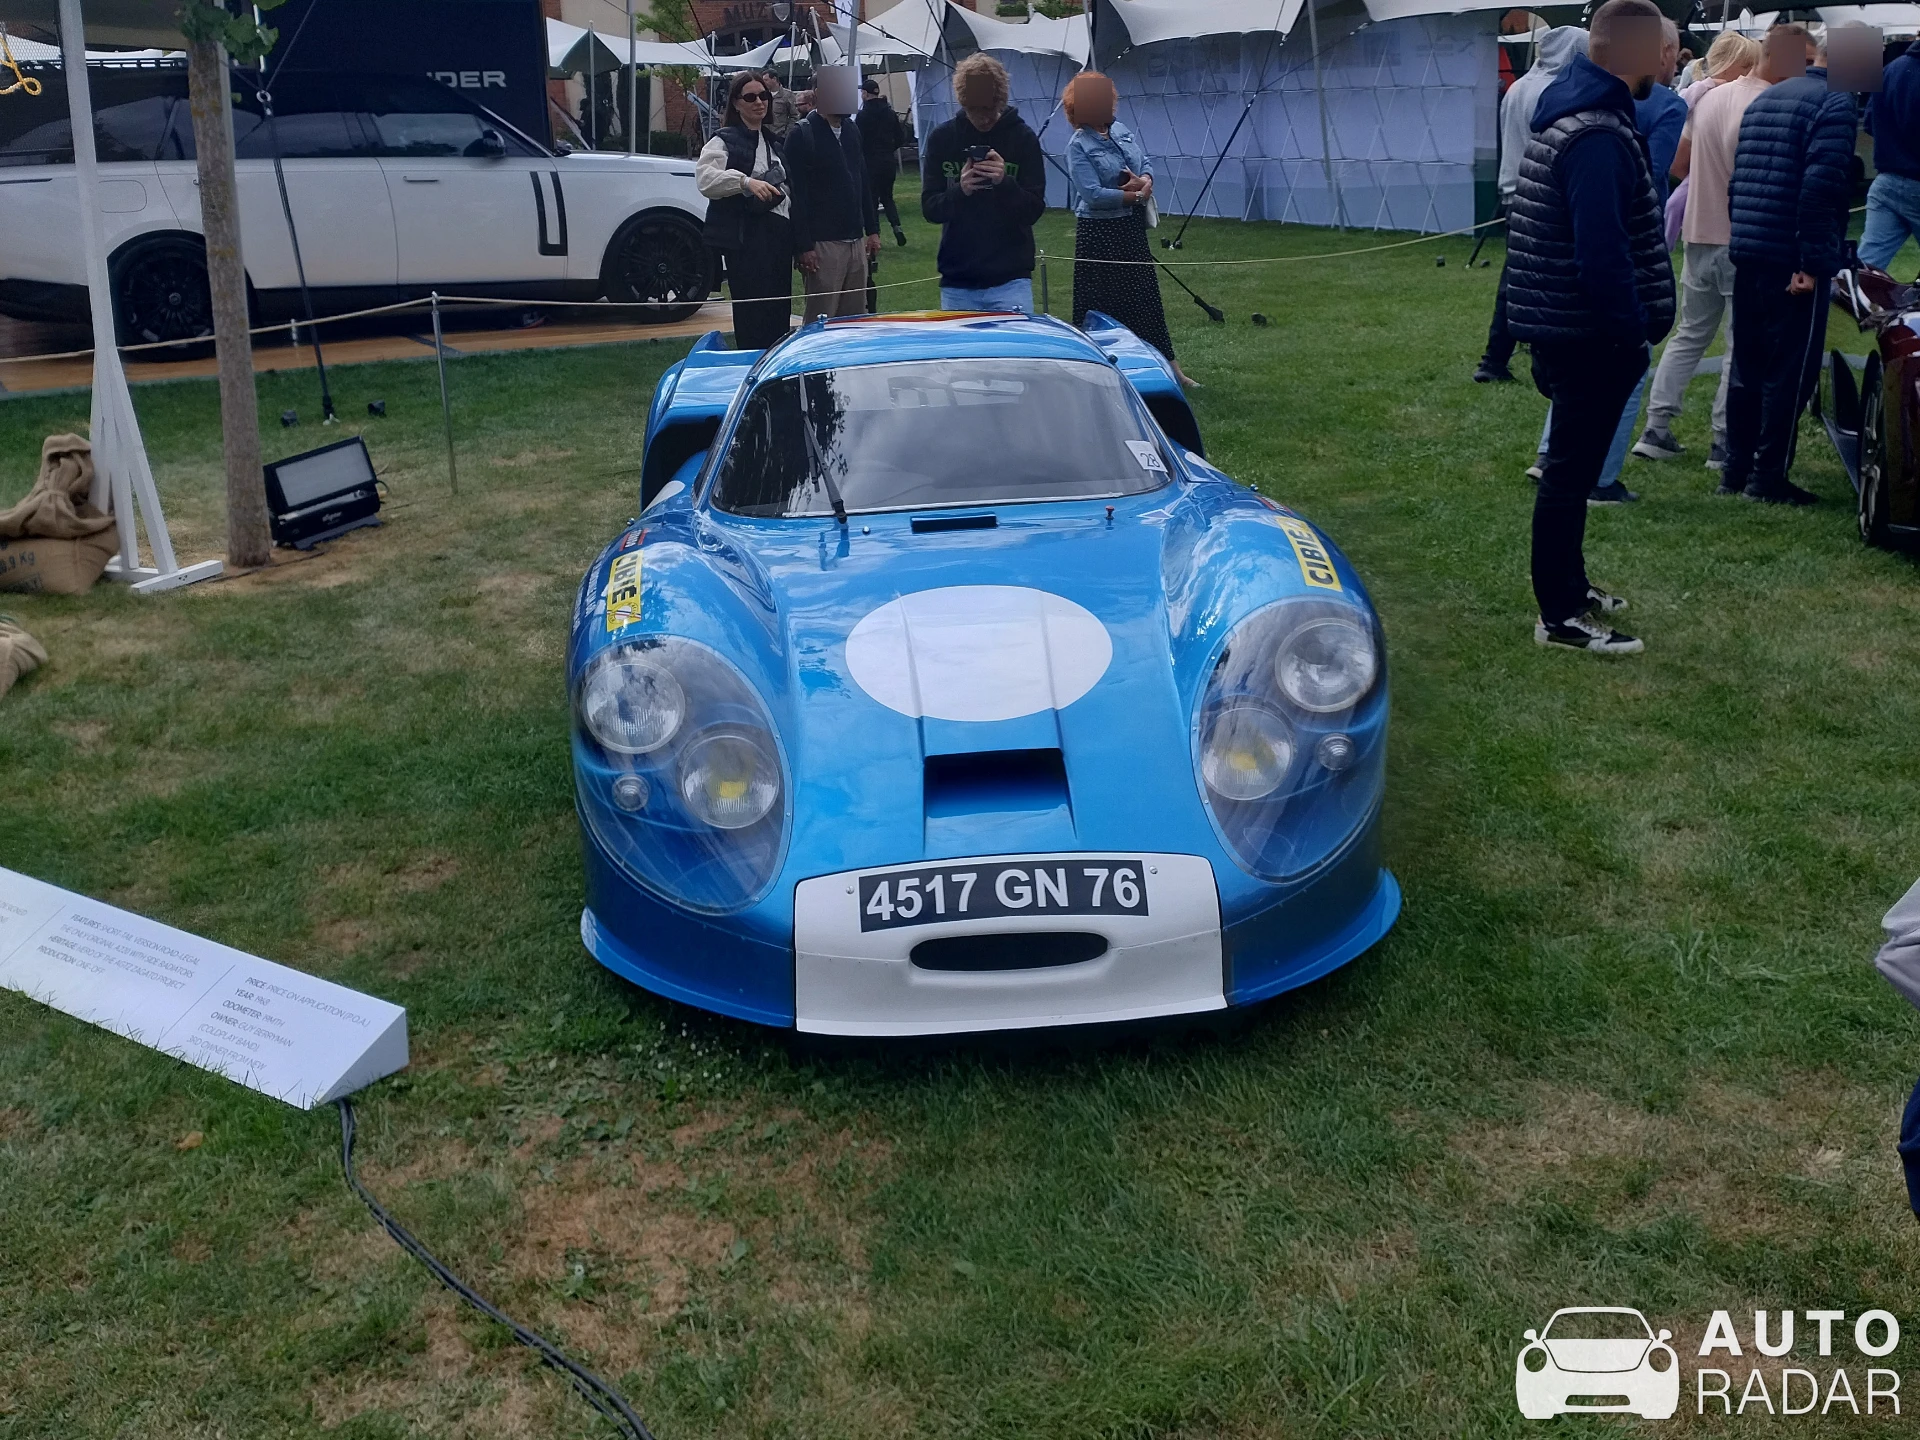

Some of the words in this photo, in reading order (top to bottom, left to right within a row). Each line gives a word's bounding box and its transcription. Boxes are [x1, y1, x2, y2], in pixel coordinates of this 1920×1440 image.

[426, 71, 507, 88] DER
[1140, 453, 1161, 467] 28
[866, 873, 978, 921] 4517
[995, 868, 1069, 909] GN
[1083, 868, 1141, 909] 76
[265, 984, 287, 995] PRICE
[285, 992, 300, 1000] ON
[297, 996, 346, 1016] APPLICATION
